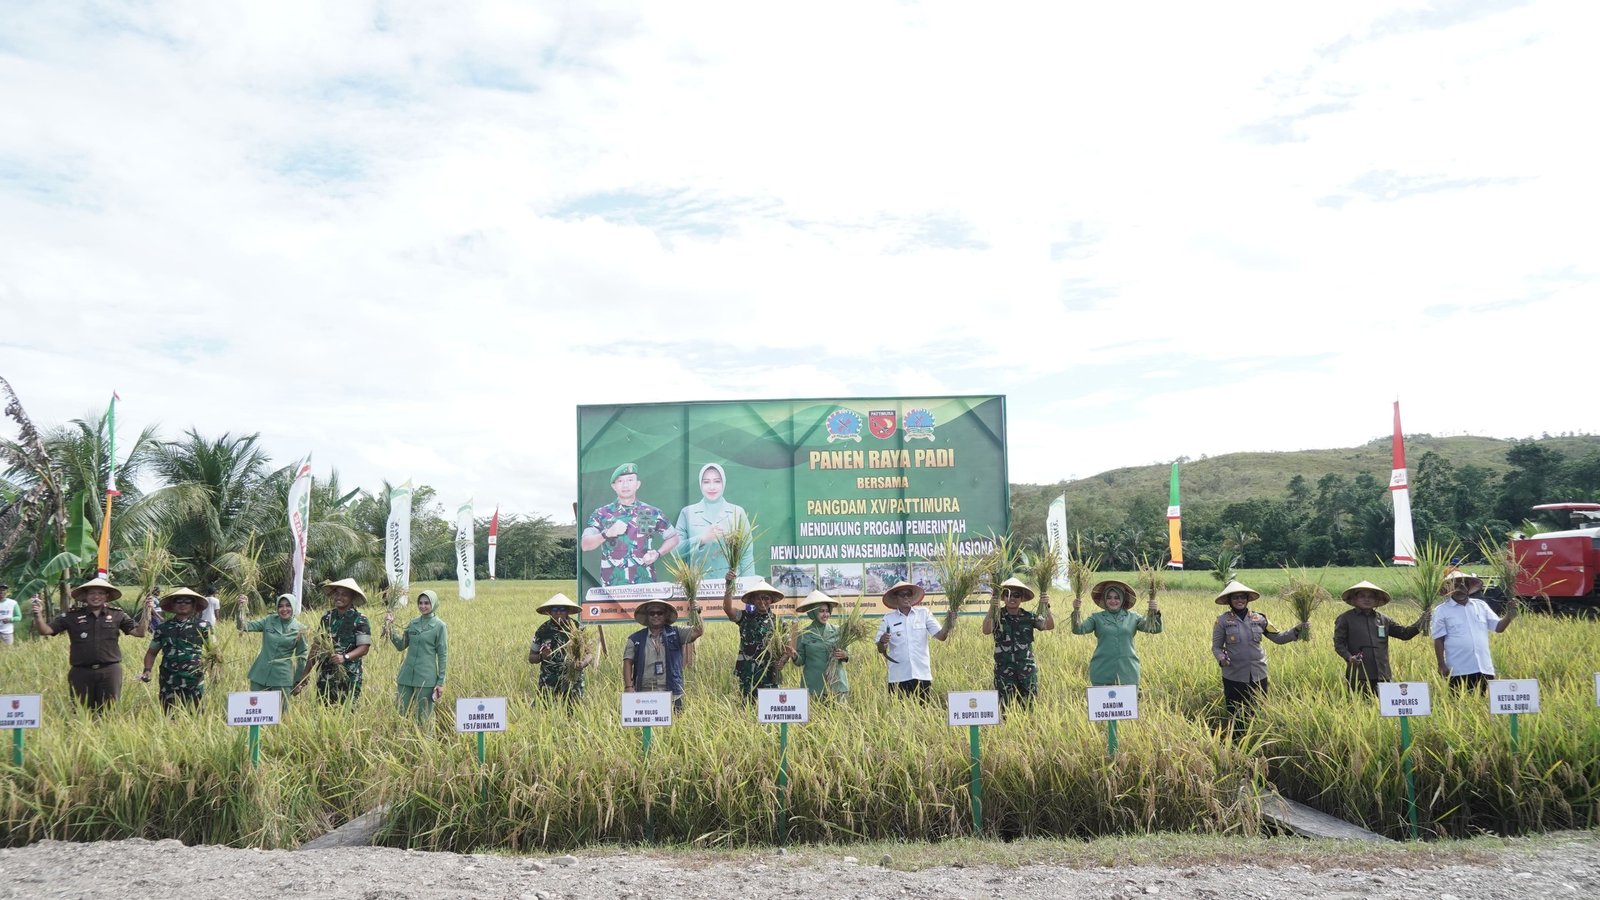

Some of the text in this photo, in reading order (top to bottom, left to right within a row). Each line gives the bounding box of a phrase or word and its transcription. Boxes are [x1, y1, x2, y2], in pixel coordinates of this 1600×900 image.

[809, 448, 955, 469] PANEN RAYA PADI
[857, 476, 909, 488] BERSAMA
[807, 497, 960, 515] PANGDAM XV/PATTIMURA
[800, 519, 966, 537] MENDUKUNG PROGAM PEMERINTAH
[771, 545, 838, 560] MEWUJUDKAN
[841, 543, 905, 558] SWASEMBADA
